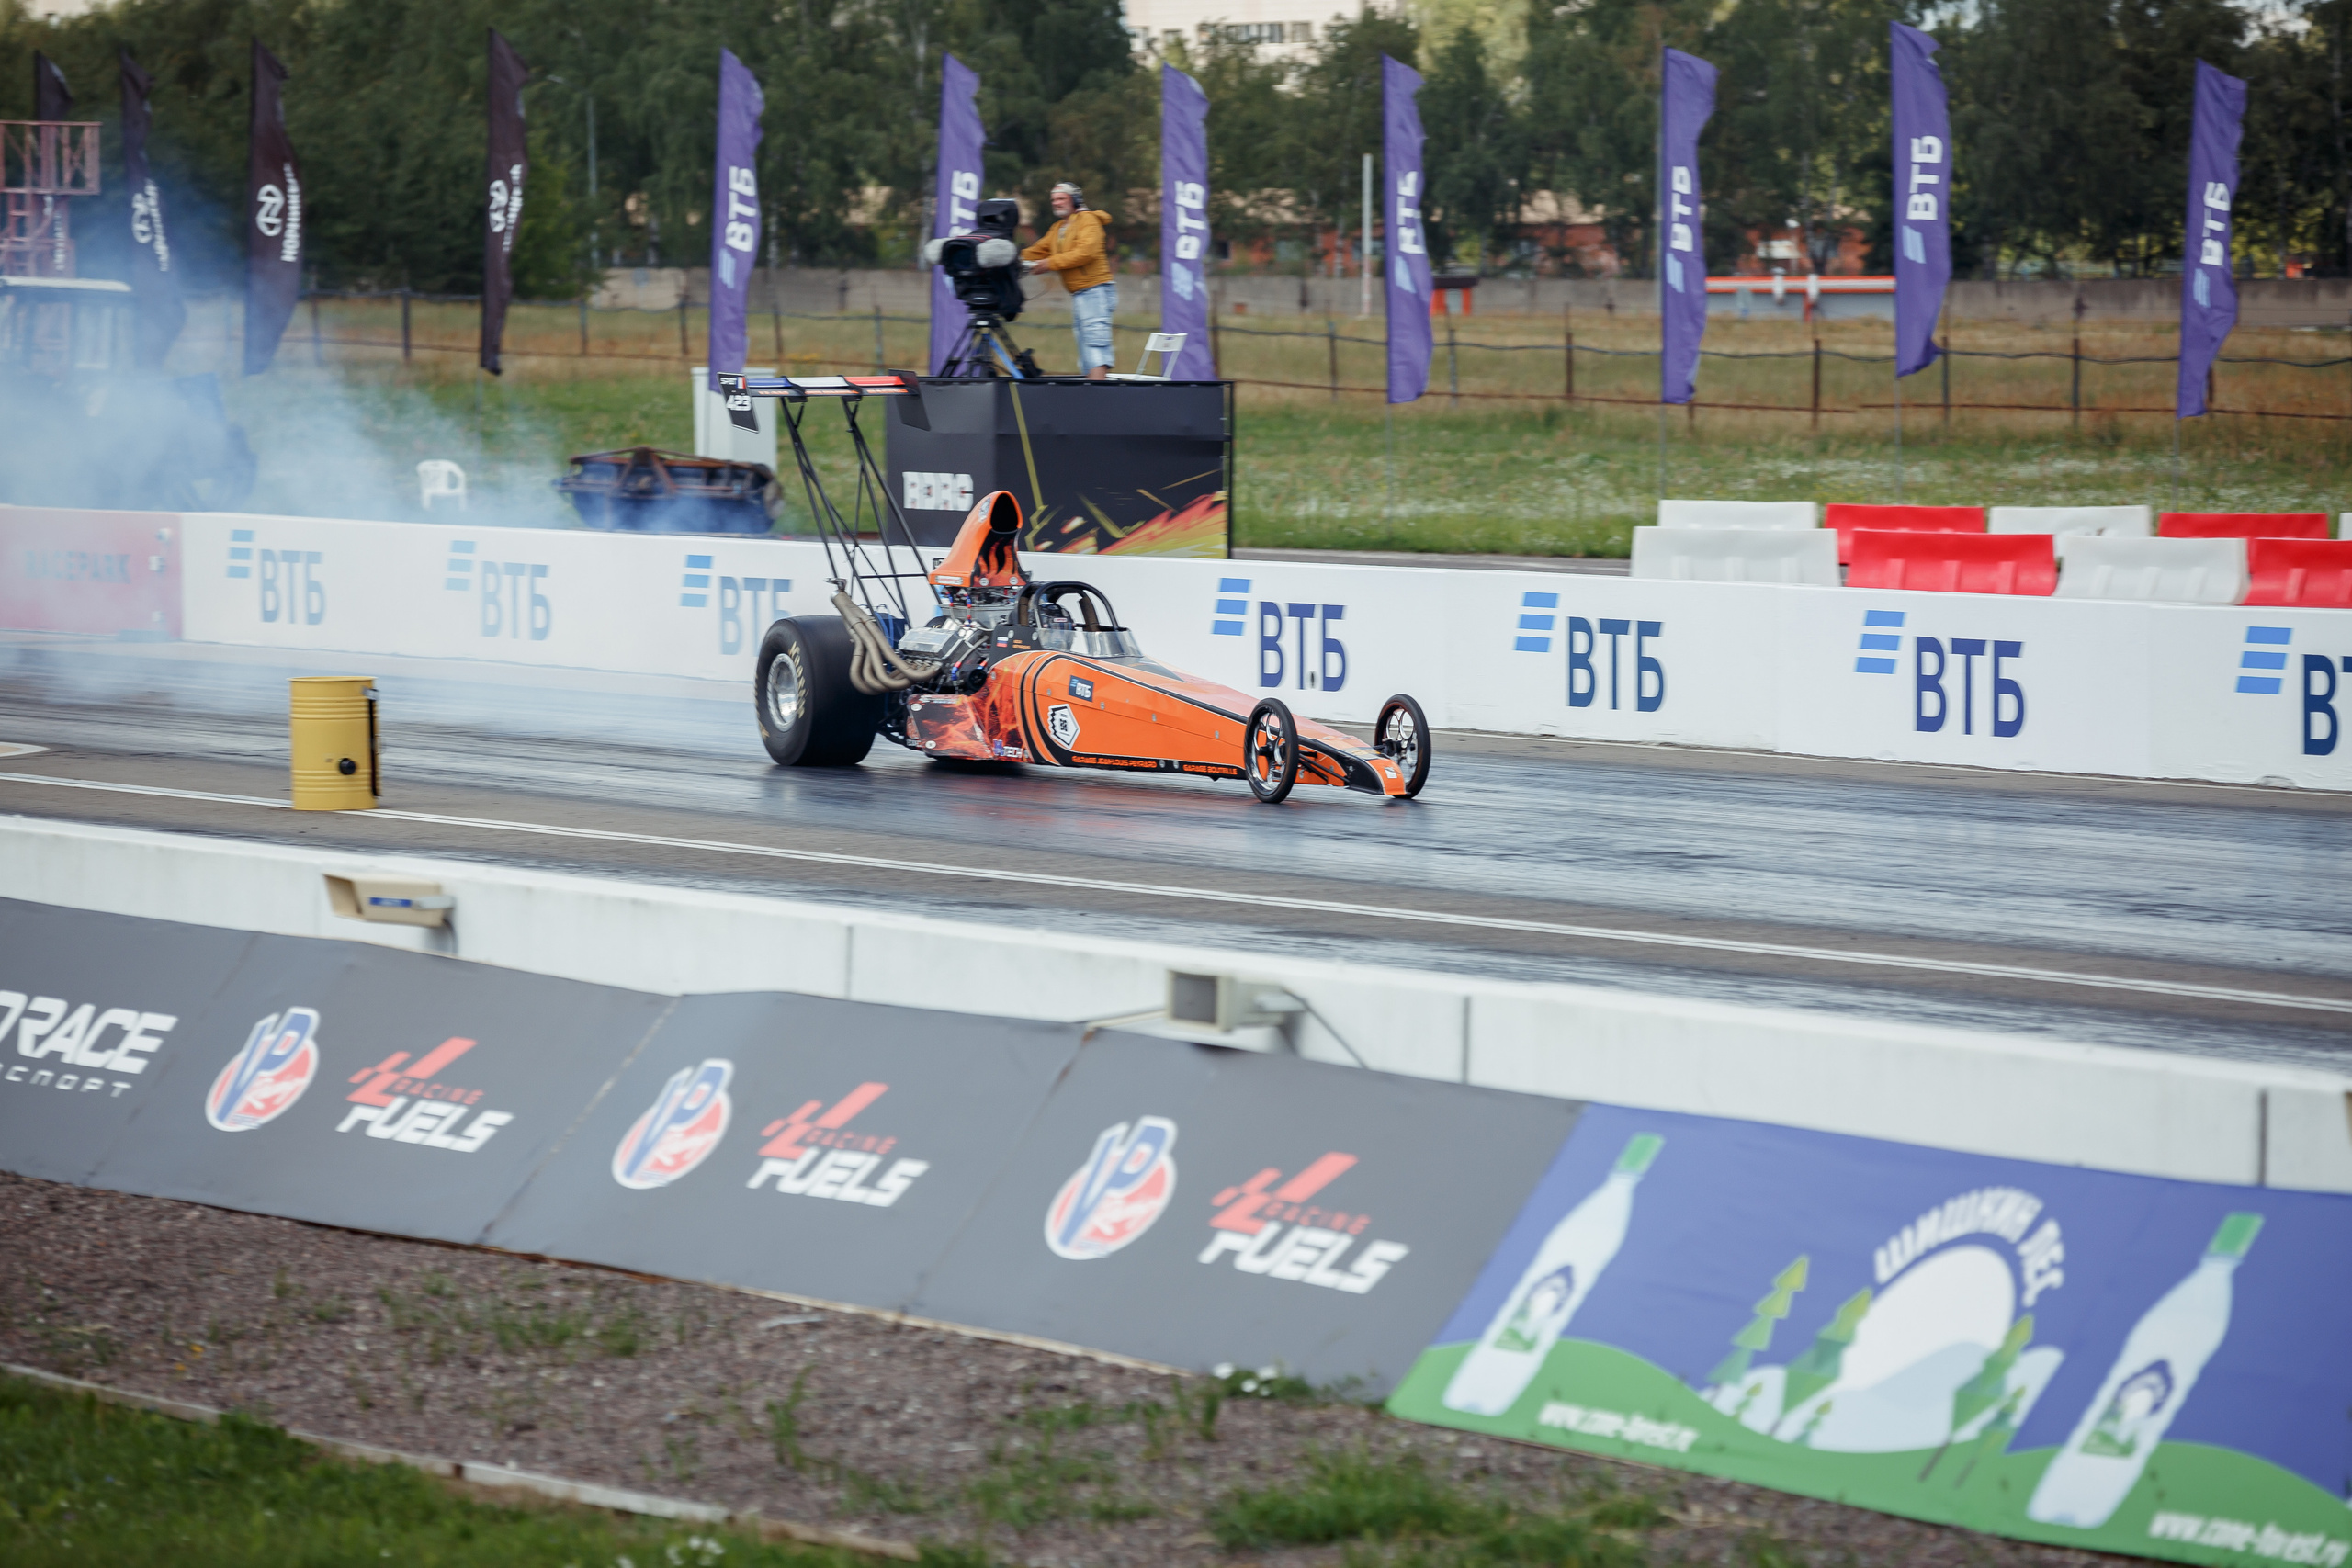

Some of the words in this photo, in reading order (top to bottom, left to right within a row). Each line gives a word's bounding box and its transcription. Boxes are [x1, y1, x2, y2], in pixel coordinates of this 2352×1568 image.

[725, 165, 756, 253] ВТБ
[1175, 180, 1206, 260] ВТБ
[1906, 135, 1945, 220] ВТБ
[2200, 181, 2232, 266] ВТБ
[726, 395, 752, 412] 423
[258, 548, 327, 626] ВТБ
[479, 560, 552, 641] ВТБ
[1259, 601, 1350, 692] ВТБ
[1566, 616, 1668, 713] ВТБ
[1914, 636, 2027, 738] ВТБ
[1075, 682, 1091, 698] ВТБ
